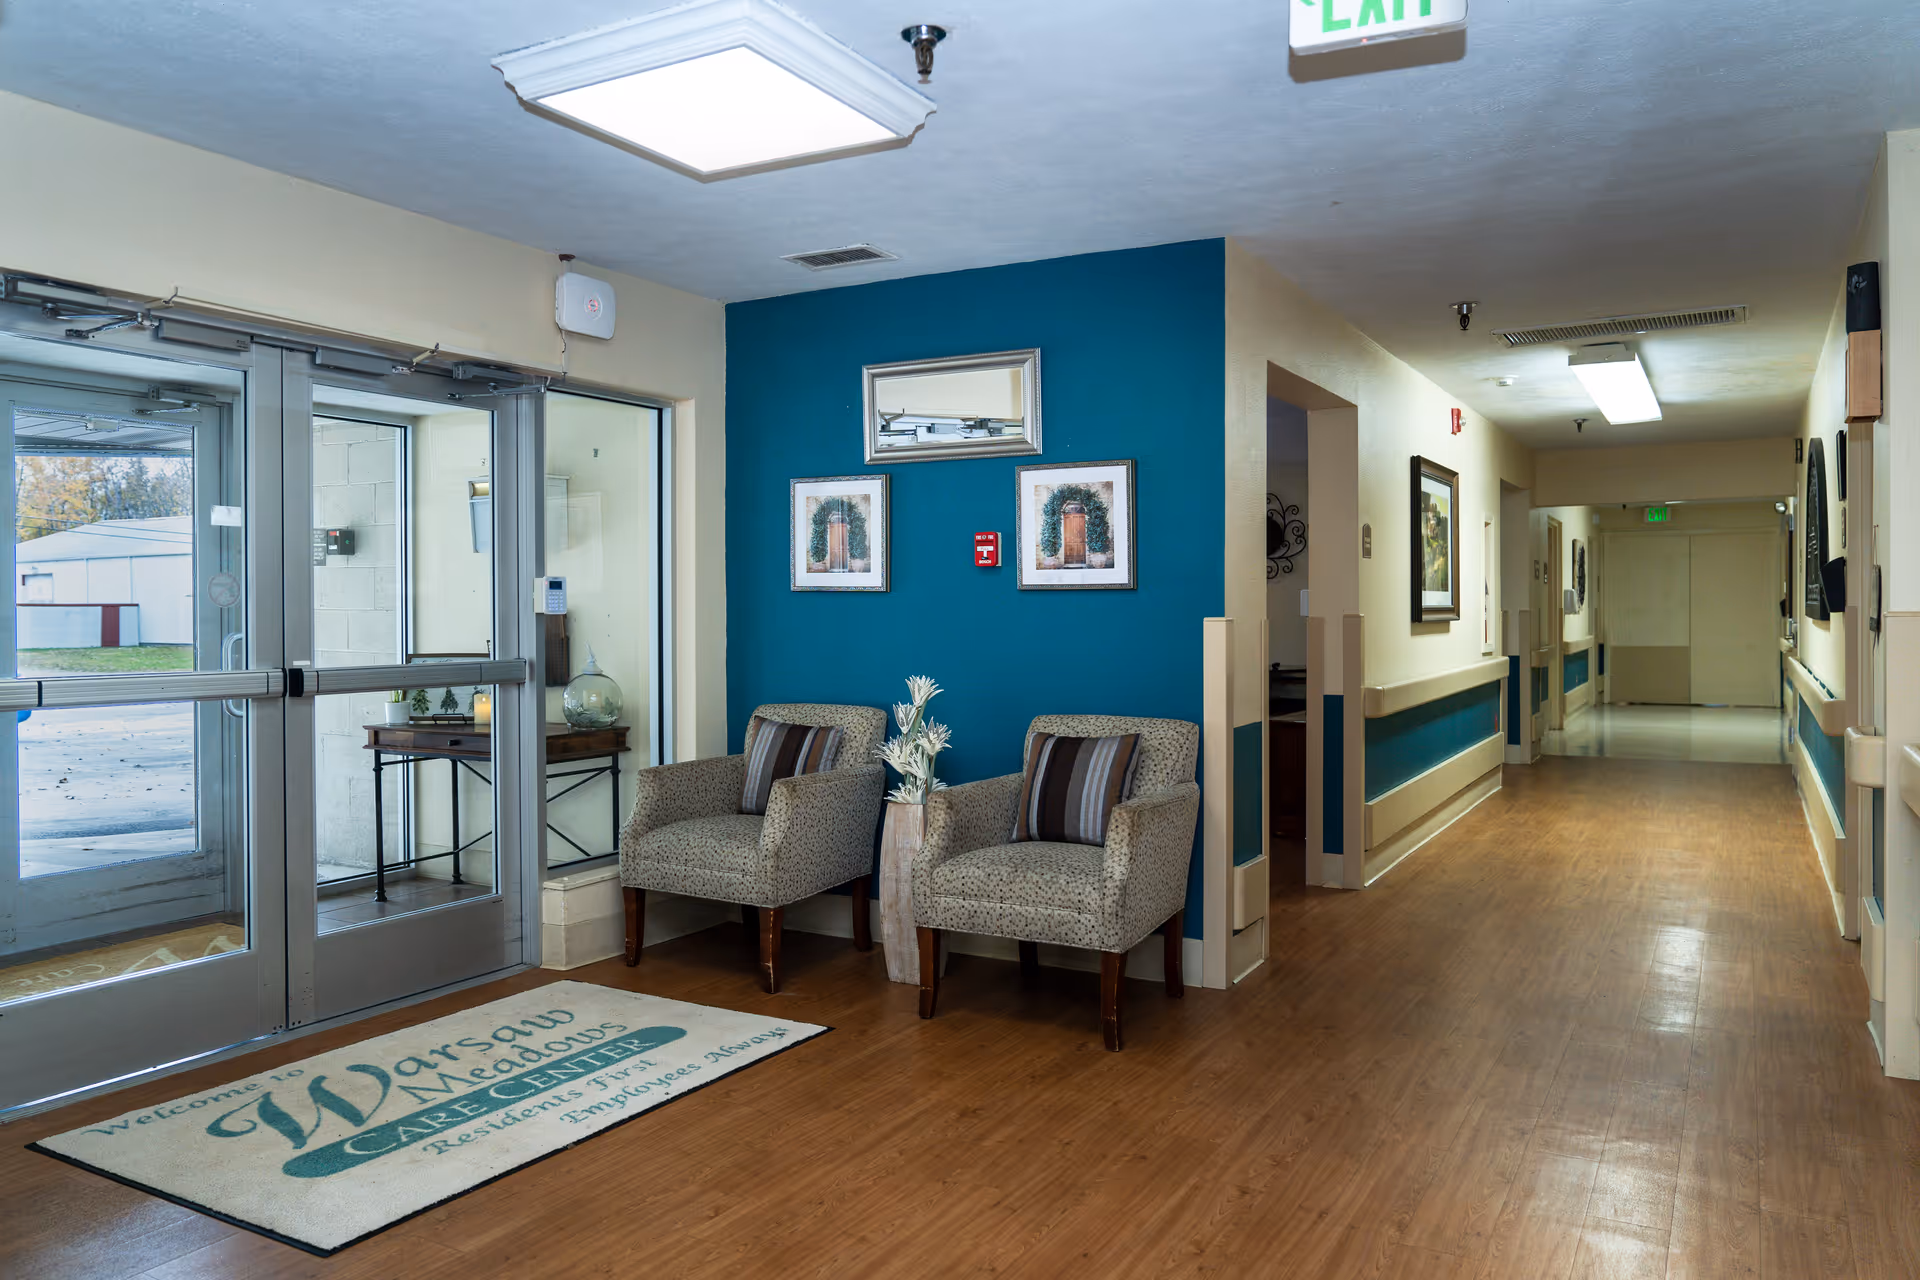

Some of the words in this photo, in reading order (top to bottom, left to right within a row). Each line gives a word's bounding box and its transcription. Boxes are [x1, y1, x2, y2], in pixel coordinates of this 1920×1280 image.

[1648, 507, 1667, 521] EXIT
[80, 1083, 263, 1136] Welcome
[269, 1069, 305, 1082] to
[206, 1009, 575, 1150] Warsaw
[344, 1102, 487, 1155] CARE
[489, 1038, 656, 1099] CENTER
[398, 1021, 628, 1105] Meadows
[422, 1087, 583, 1155] Residents
[586, 1058, 658, 1092] First
[559, 1061, 702, 1124] Employees
[704, 1026, 791, 1064] Always
